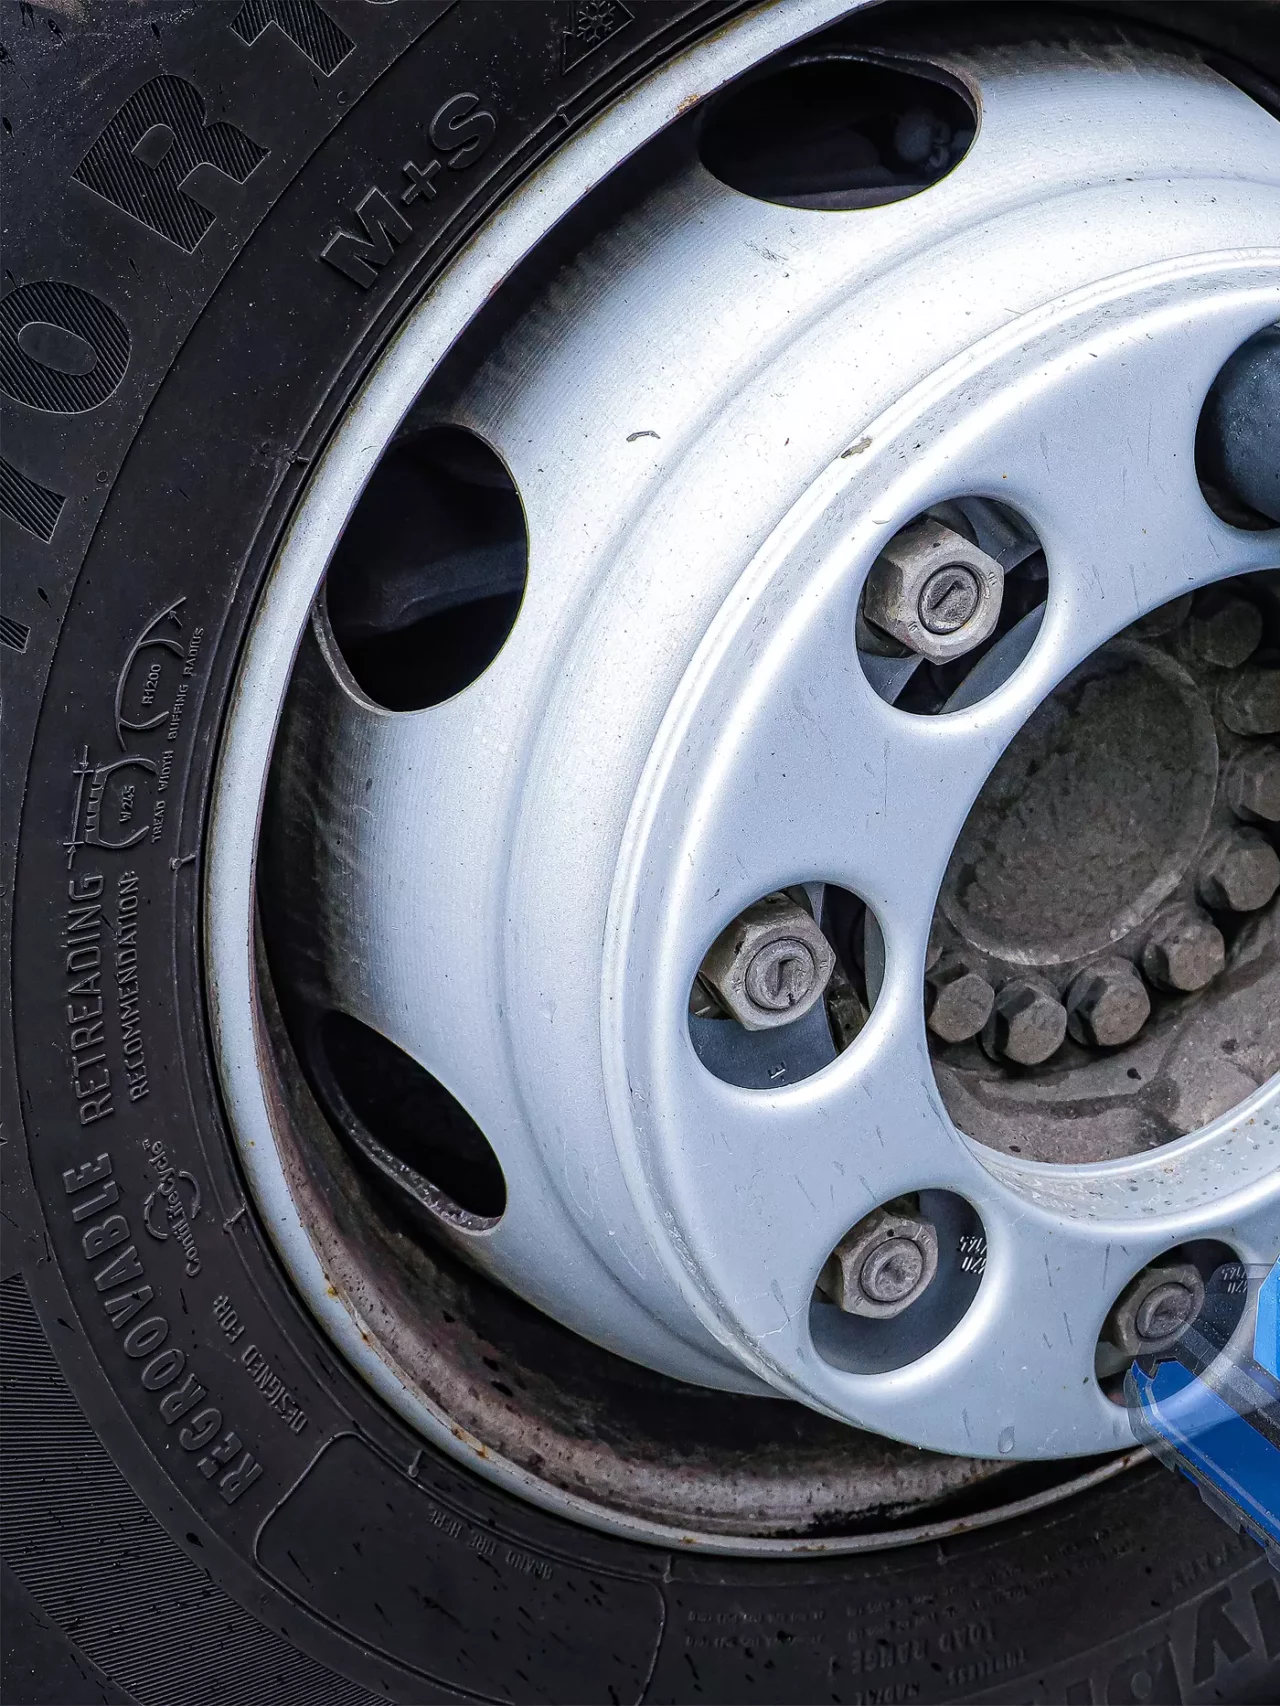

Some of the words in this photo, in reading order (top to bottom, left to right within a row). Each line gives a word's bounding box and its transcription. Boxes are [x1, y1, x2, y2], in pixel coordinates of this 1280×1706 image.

[320, 91, 497, 290] M+S
[141, 663, 161, 705] R1200
[167, 684, 189, 741] BUFFING
[183, 627, 205, 677] RADIUS
[150, 800, 166, 844] TREAD
[158, 750, 174, 792] WIDTH
[67, 872, 115, 1126] RETREADING
[114, 870, 150, 1103] RECOMMENDATION:
[62, 1152, 264, 1505] REGROOVABLE
[241, 1344, 308, 1435] DESIGNED
